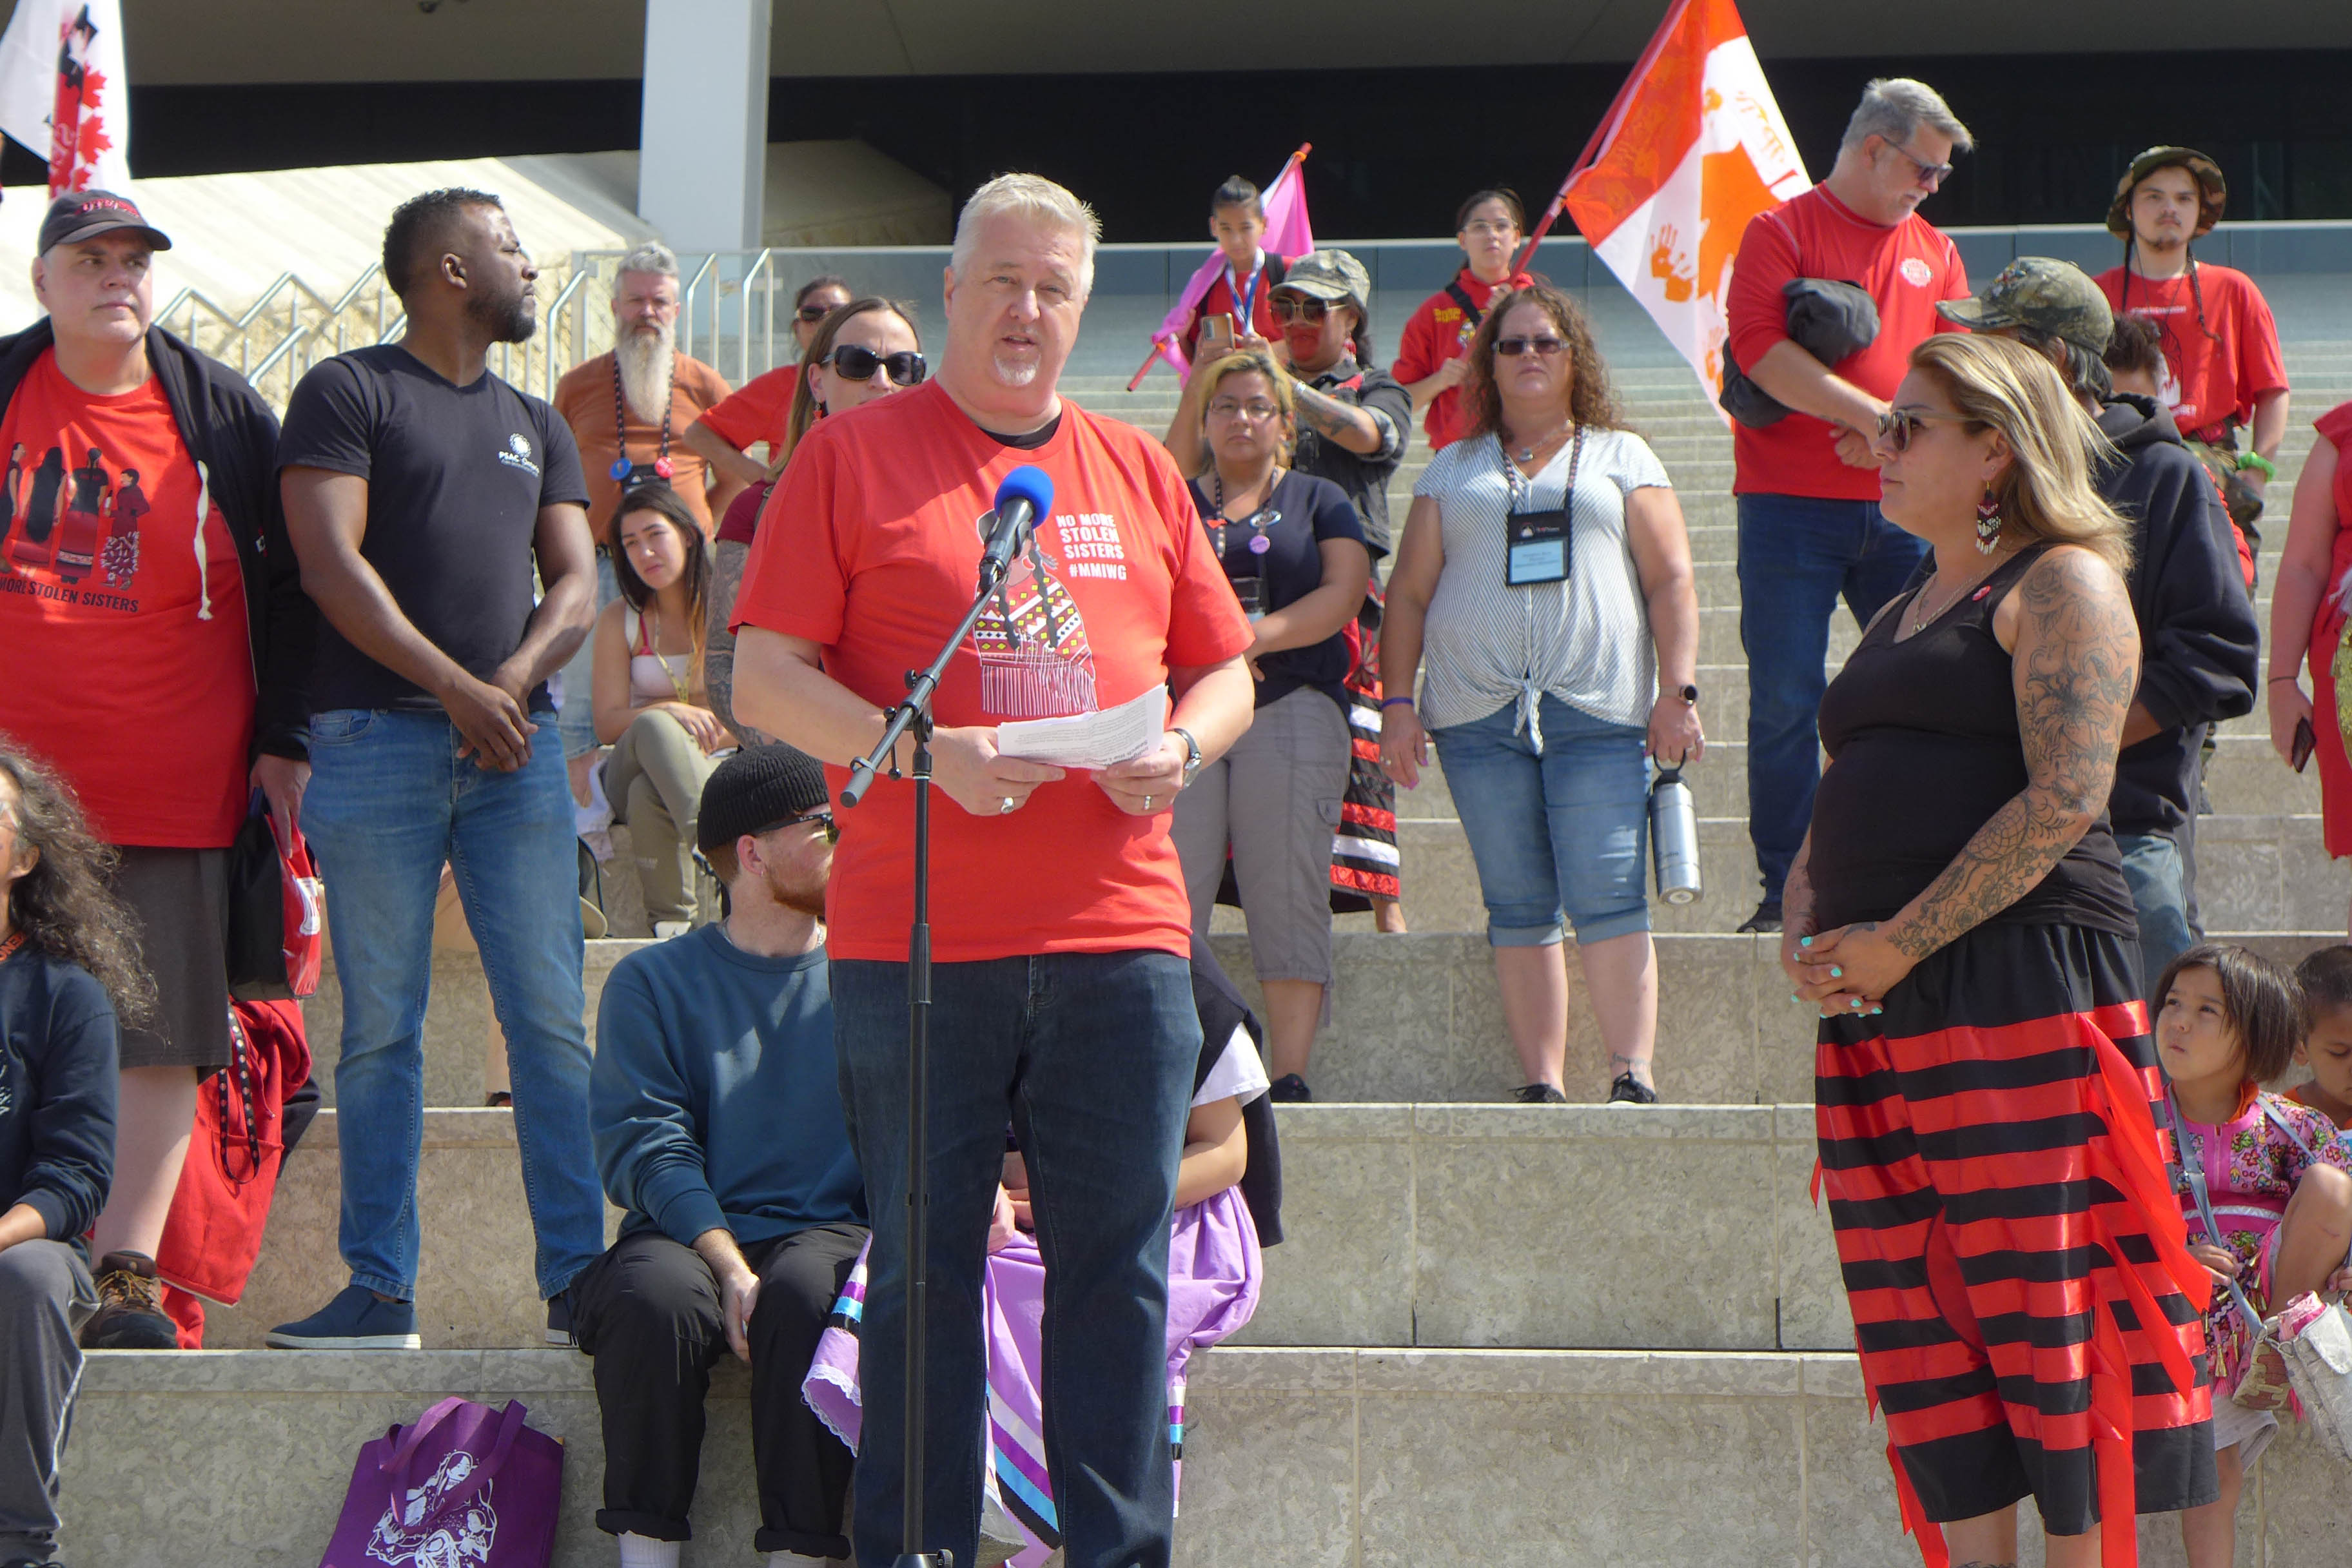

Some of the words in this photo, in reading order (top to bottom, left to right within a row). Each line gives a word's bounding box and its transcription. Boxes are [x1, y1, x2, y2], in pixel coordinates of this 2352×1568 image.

[498, 451, 520, 463] PSAC
[1055, 514, 1077, 528] NO
[1079, 513, 1116, 528] MORE
[1059, 526, 1121, 544] STOLEN
[1063, 543, 1124, 560] SISTERS
[1068, 562, 1127, 581] #MMIWG
[28, 581, 79, 604] STOLEN
[82, 592, 139, 613] SISTERS
